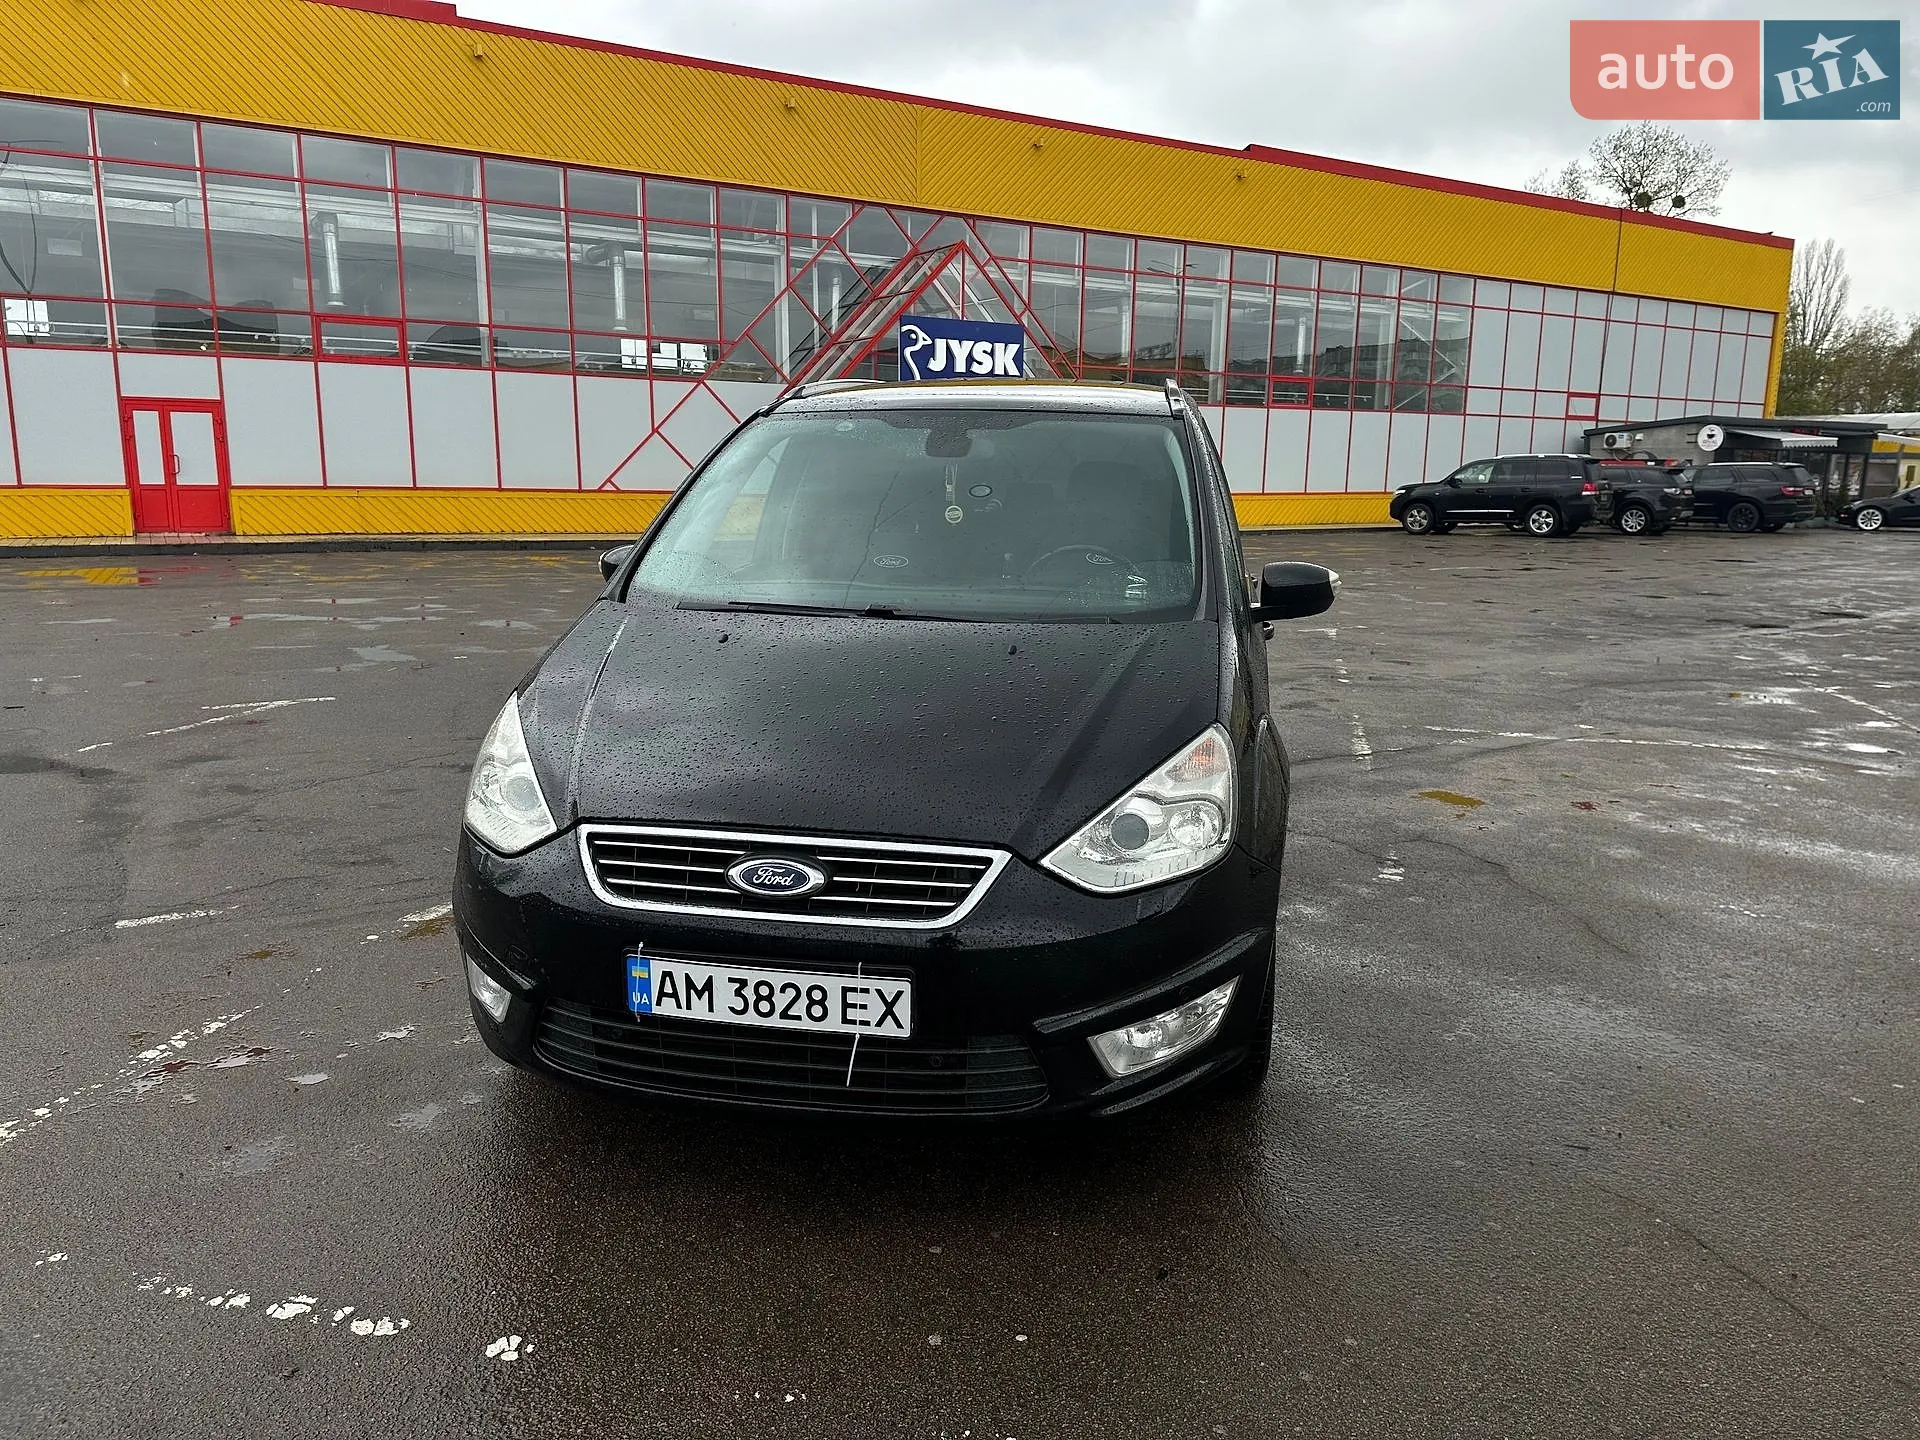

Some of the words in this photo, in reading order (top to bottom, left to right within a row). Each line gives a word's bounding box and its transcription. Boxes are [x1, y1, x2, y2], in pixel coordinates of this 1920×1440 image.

[927, 338, 1021, 376] JYSK
[752, 866, 795, 886] Ford
[632, 991, 650, 1005] UA
[655, 970, 715, 1013] AM
[727, 976, 829, 1022] 3828
[841, 985, 905, 1030] EX
